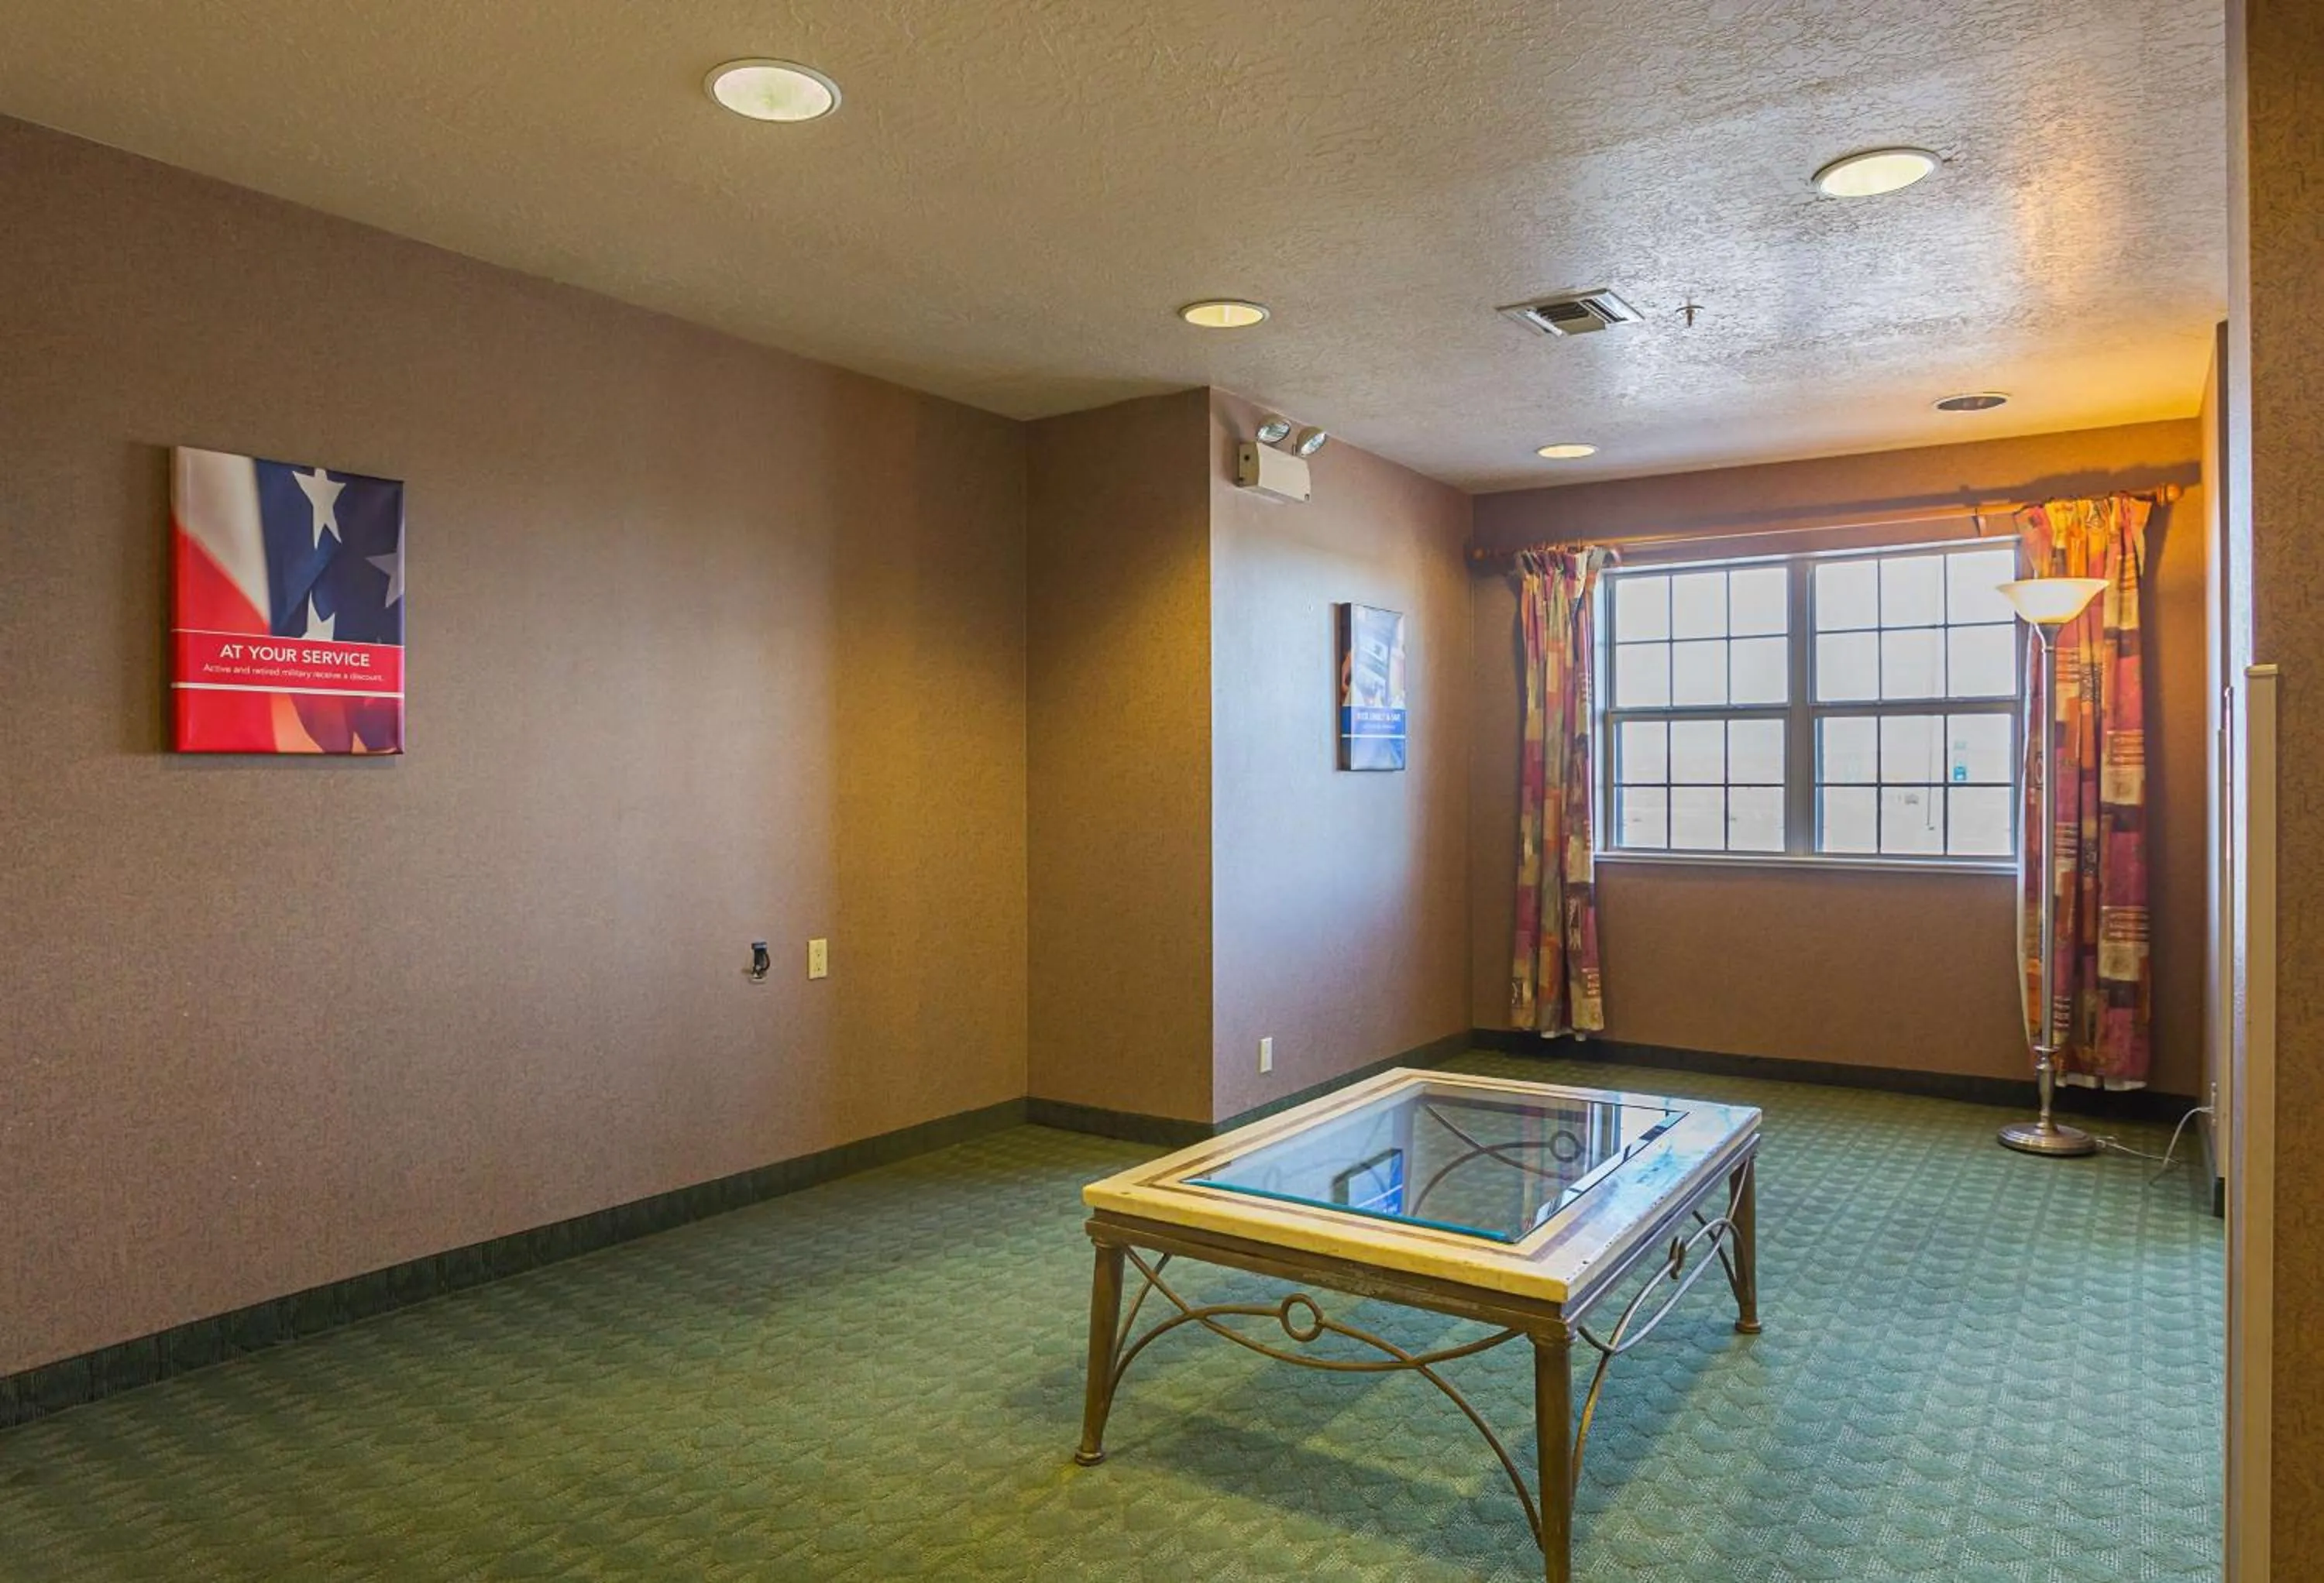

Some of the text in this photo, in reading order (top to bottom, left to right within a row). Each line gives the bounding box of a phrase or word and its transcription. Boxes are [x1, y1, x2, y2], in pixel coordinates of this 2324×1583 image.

[219, 644, 370, 667] AT YOUR SERVICE
[203, 662, 232, 674] Active
[233, 665, 251, 675] and
[252, 667, 280, 676] retired
[281, 668, 311, 679] military
